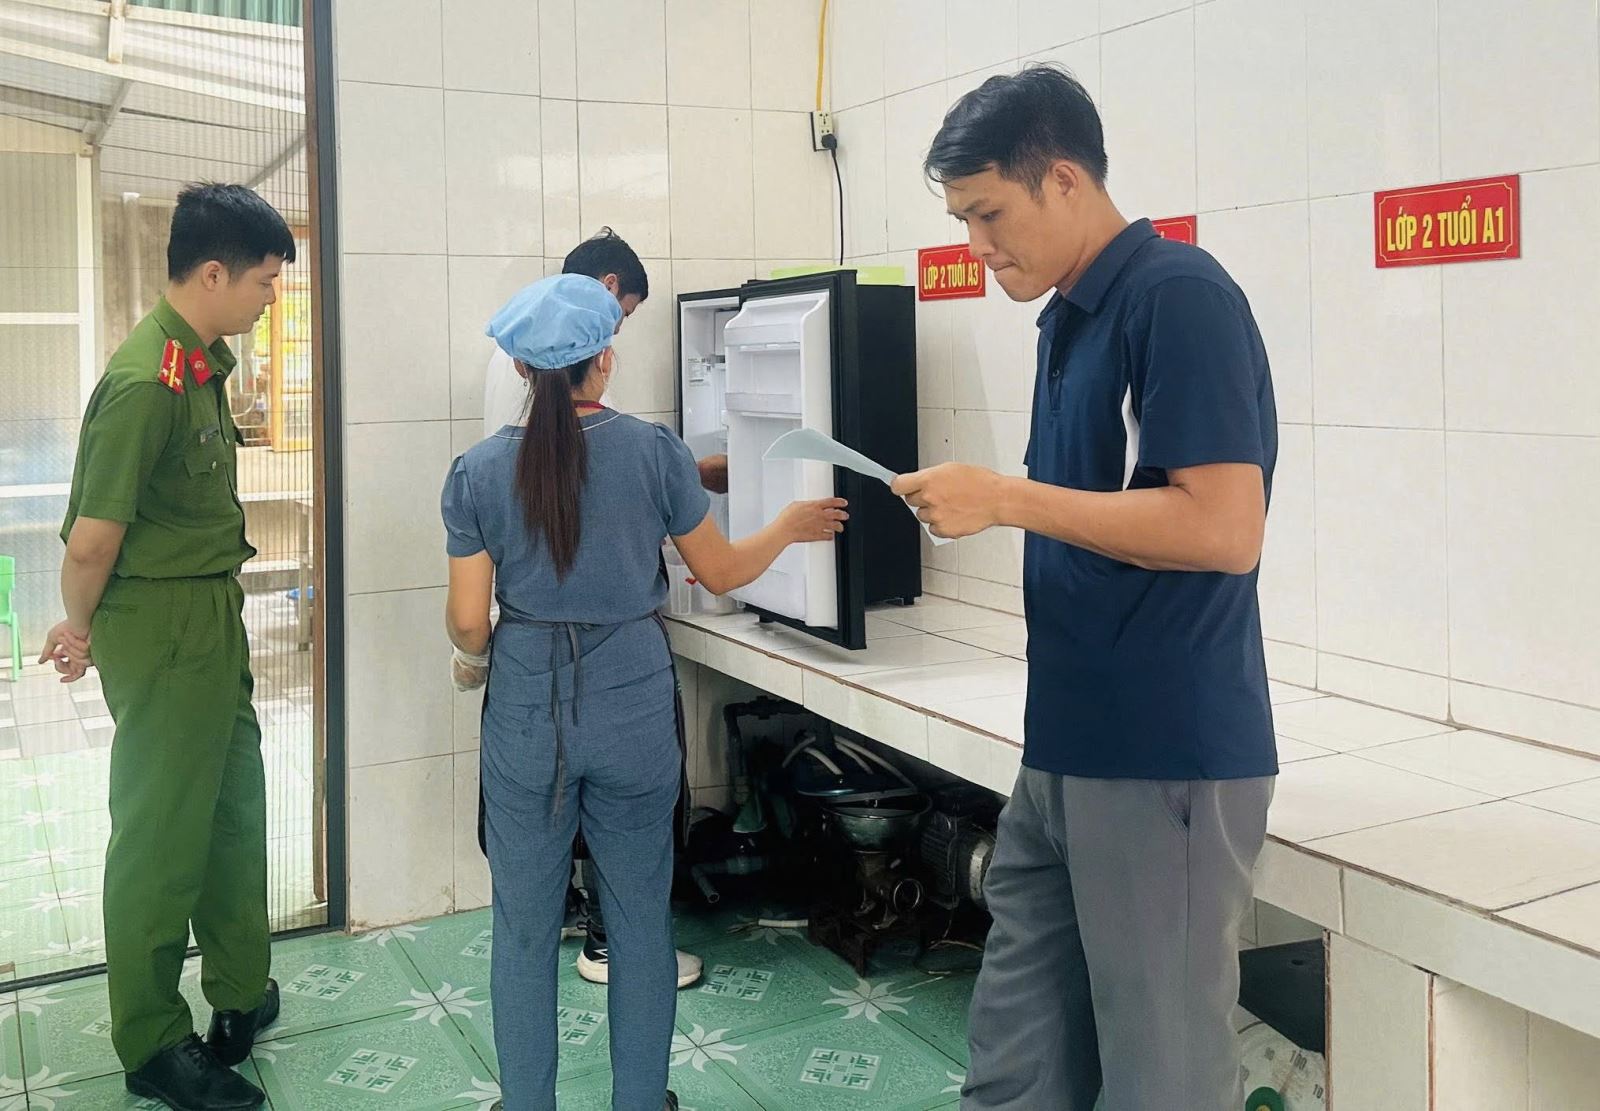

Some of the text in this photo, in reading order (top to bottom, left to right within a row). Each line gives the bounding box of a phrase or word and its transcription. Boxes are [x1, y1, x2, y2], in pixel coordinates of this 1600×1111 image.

[1386, 194, 1504, 252] LỚP 2 TUỔI A1
[923, 252, 979, 290] LỚP 2 TUỔI A3
